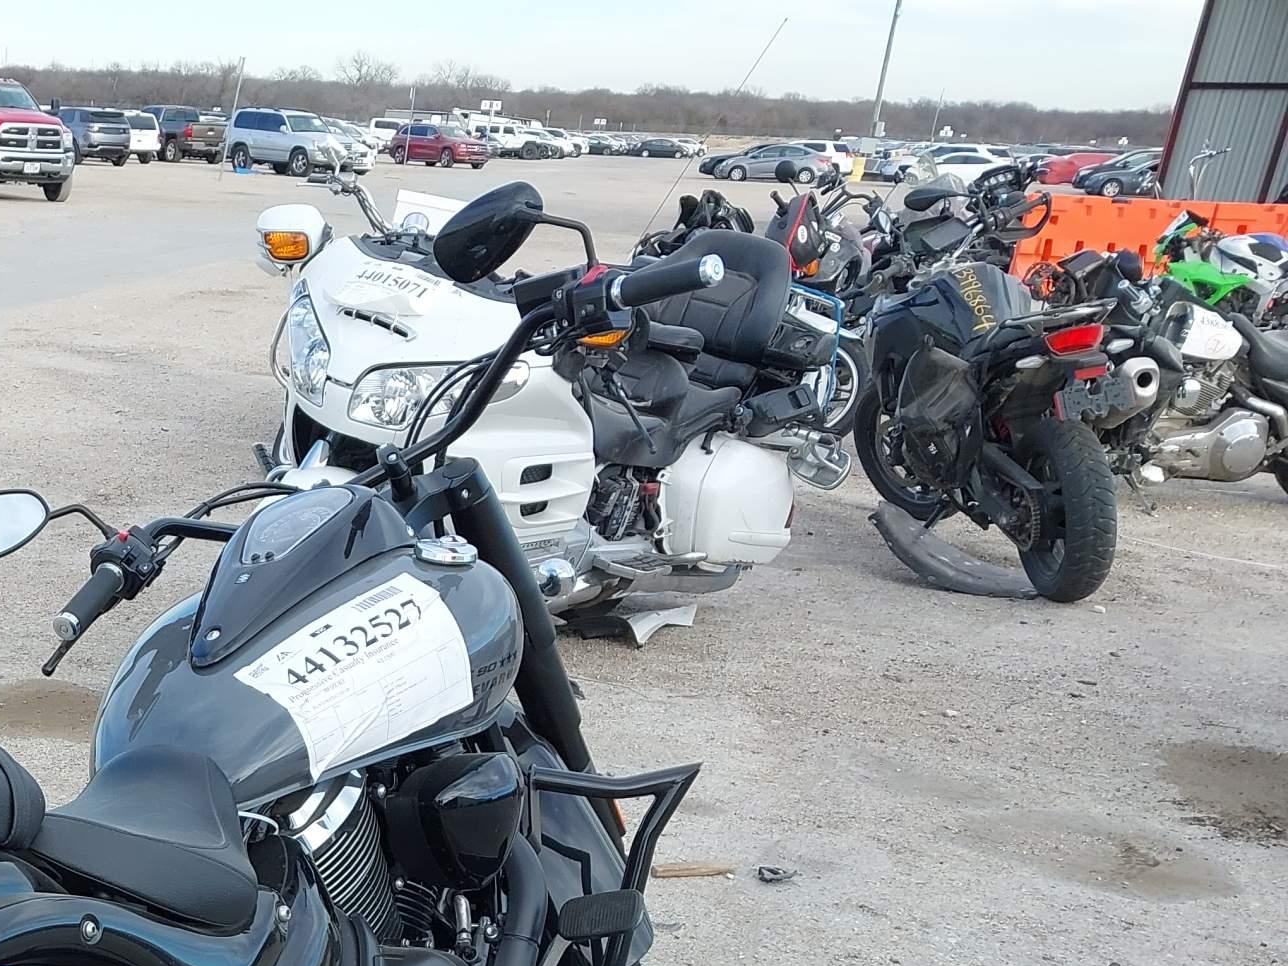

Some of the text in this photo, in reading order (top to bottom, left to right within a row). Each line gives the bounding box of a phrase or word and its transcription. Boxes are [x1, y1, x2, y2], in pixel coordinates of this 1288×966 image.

[952, 266, 997, 332] 3996864
[286, 598, 422, 686] 44132527
[287, 671, 335, 705] Progressive
[333, 655, 367, 683] Casualty
[364, 638, 400, 665] Insurance
